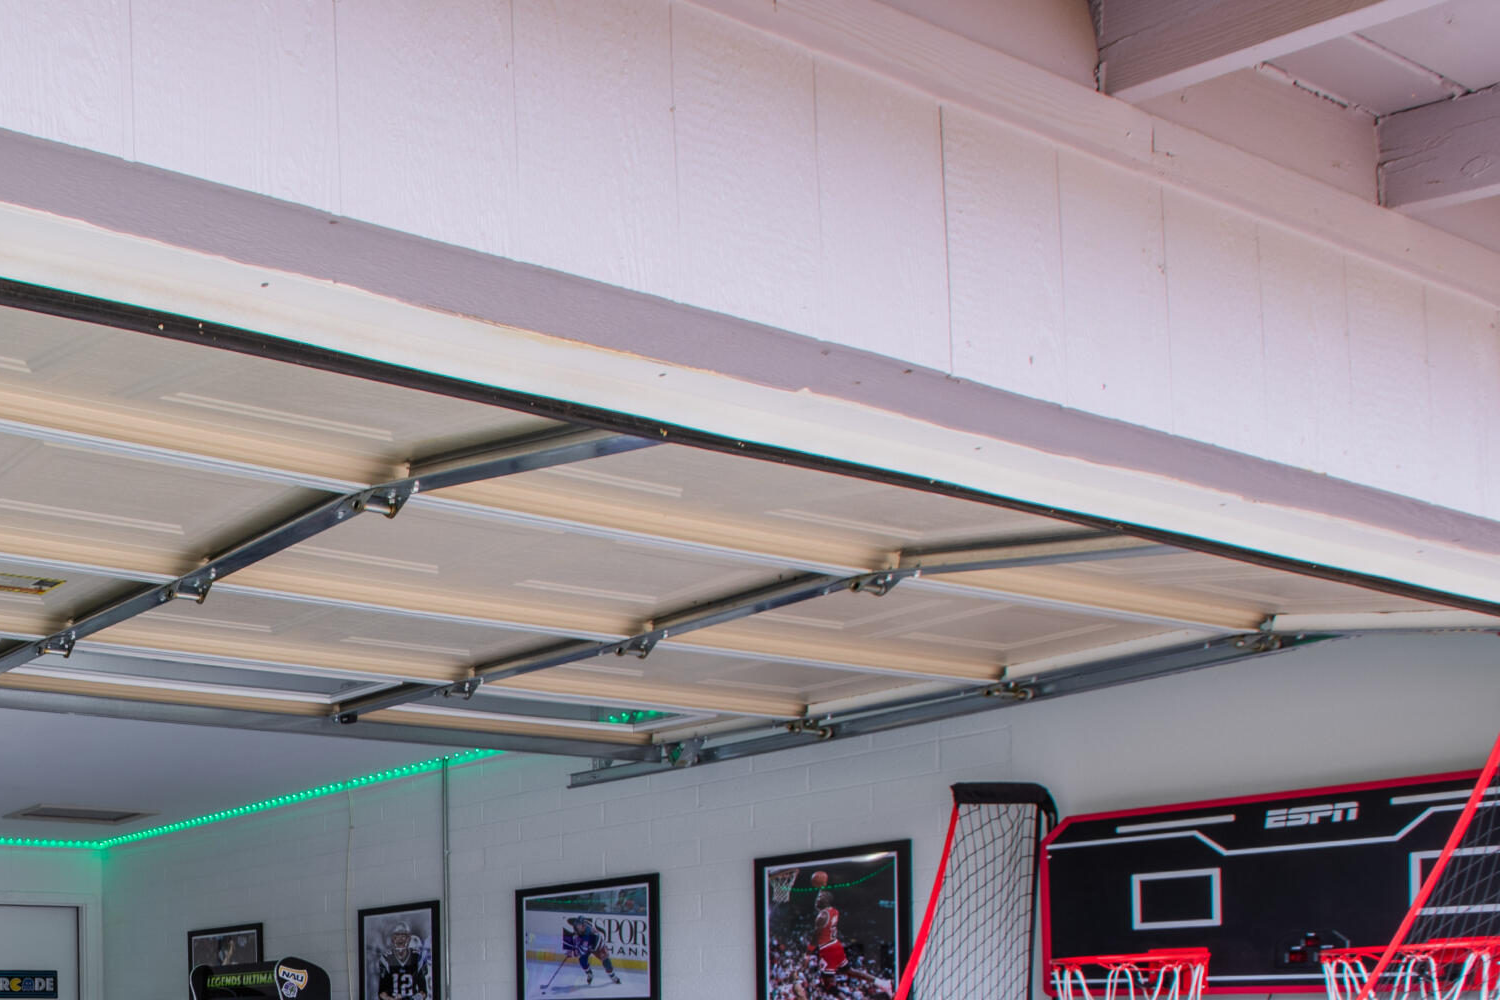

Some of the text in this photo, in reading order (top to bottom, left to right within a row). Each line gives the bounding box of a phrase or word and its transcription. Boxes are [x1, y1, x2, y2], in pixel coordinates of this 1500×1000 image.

[1264, 801, 1359, 829] ESPN
[206, 974, 241, 988] LEGENDS
[281, 970, 304, 983] NAU
[391, 973, 414, 998] 12
